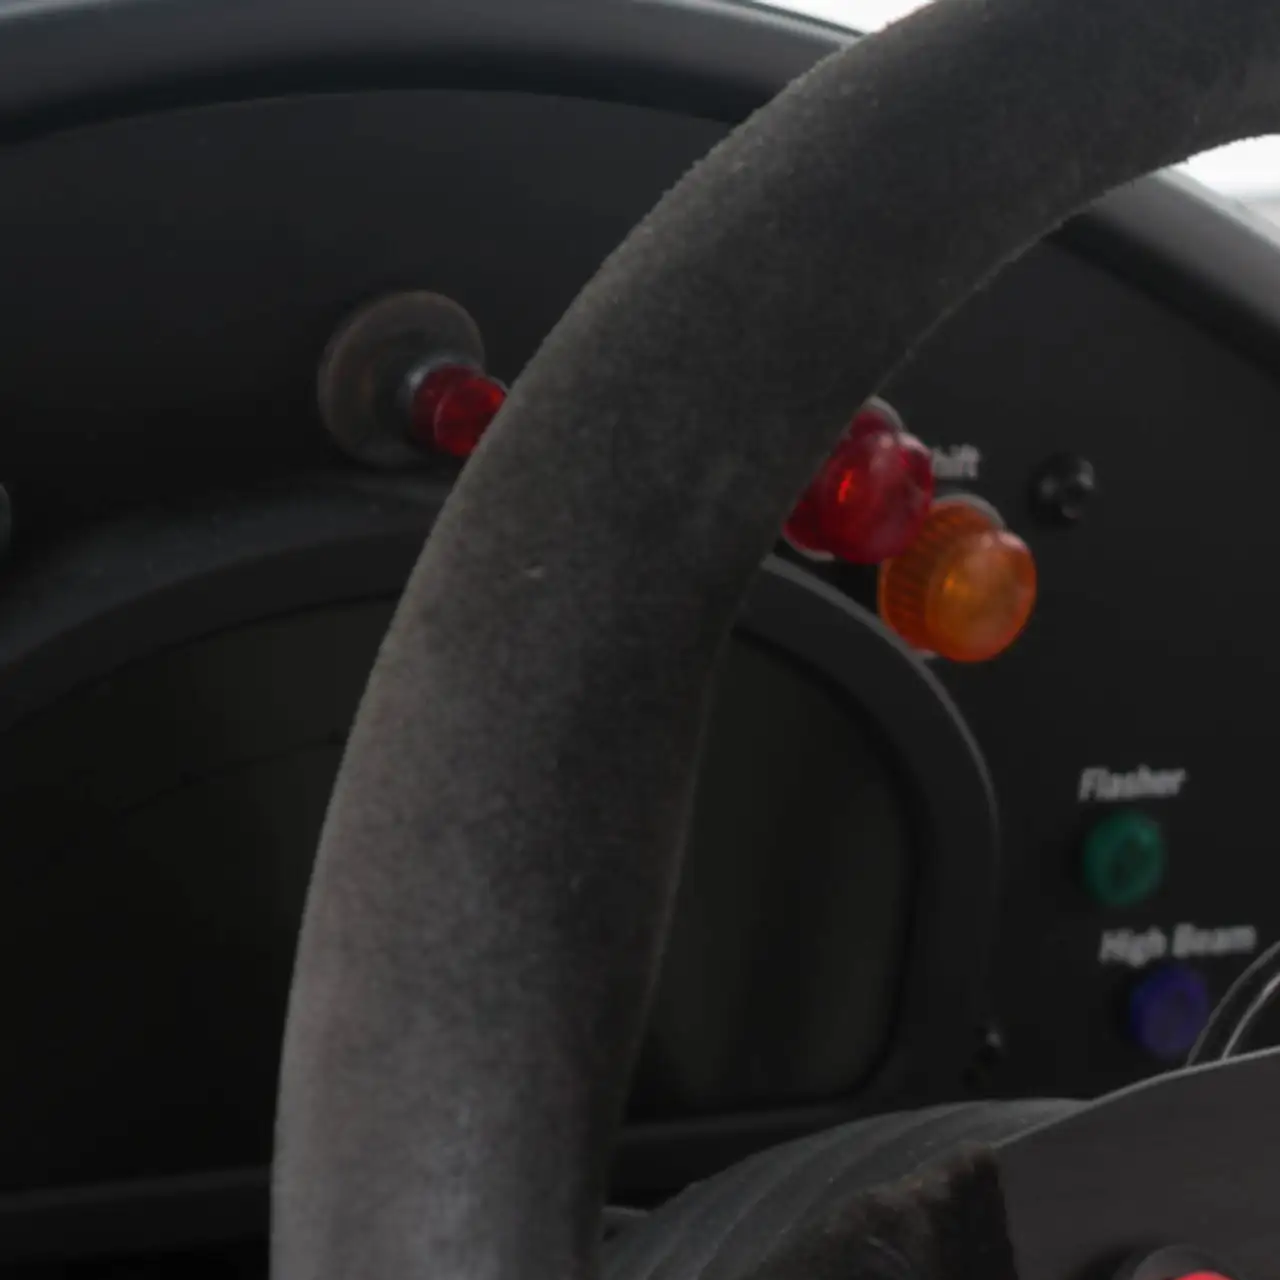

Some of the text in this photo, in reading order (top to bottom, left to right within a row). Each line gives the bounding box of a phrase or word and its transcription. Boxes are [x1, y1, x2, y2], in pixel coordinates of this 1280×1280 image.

[1078, 765, 1187, 801] Flasher
[1099, 922, 1257, 967] High Beam
